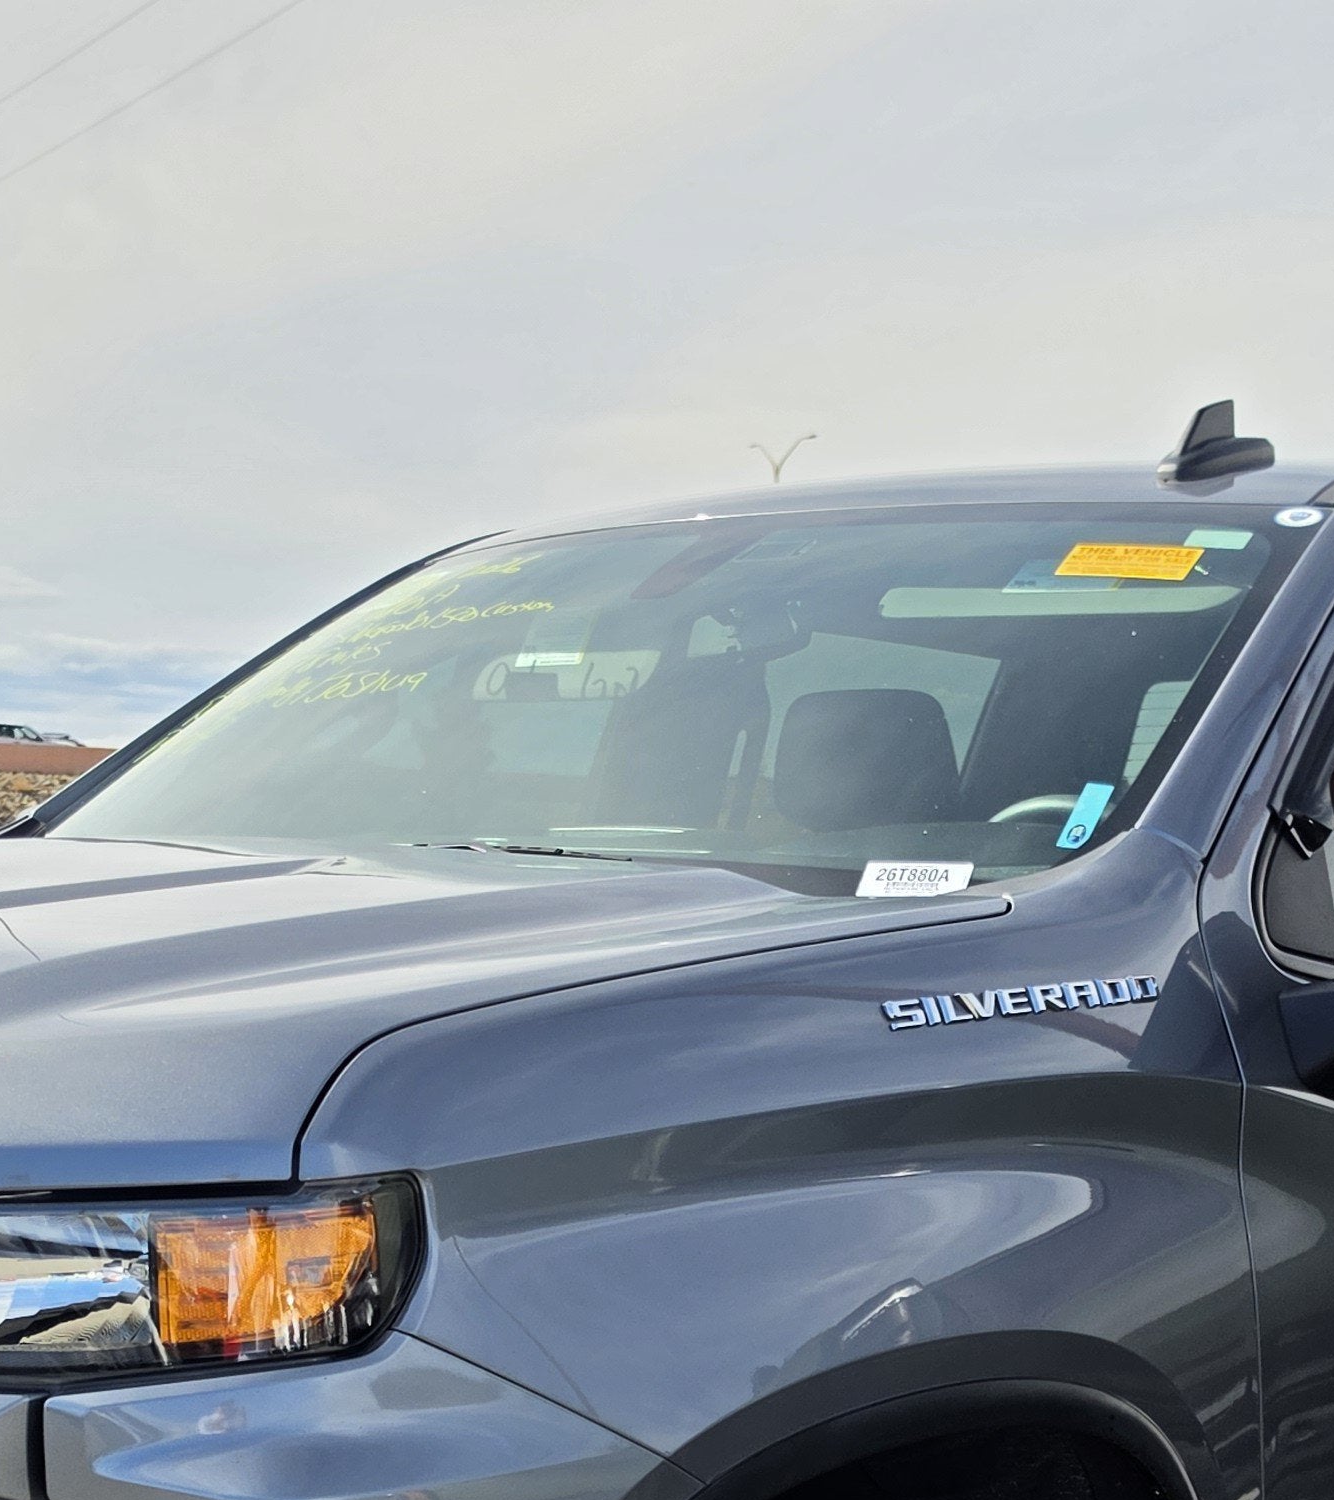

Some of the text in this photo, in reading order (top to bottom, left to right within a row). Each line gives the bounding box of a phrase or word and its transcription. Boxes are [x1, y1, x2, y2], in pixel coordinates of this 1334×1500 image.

[1079, 547, 1198, 558] THIS VEHICLE
[881, 975, 1159, 1030] SILVERADO
